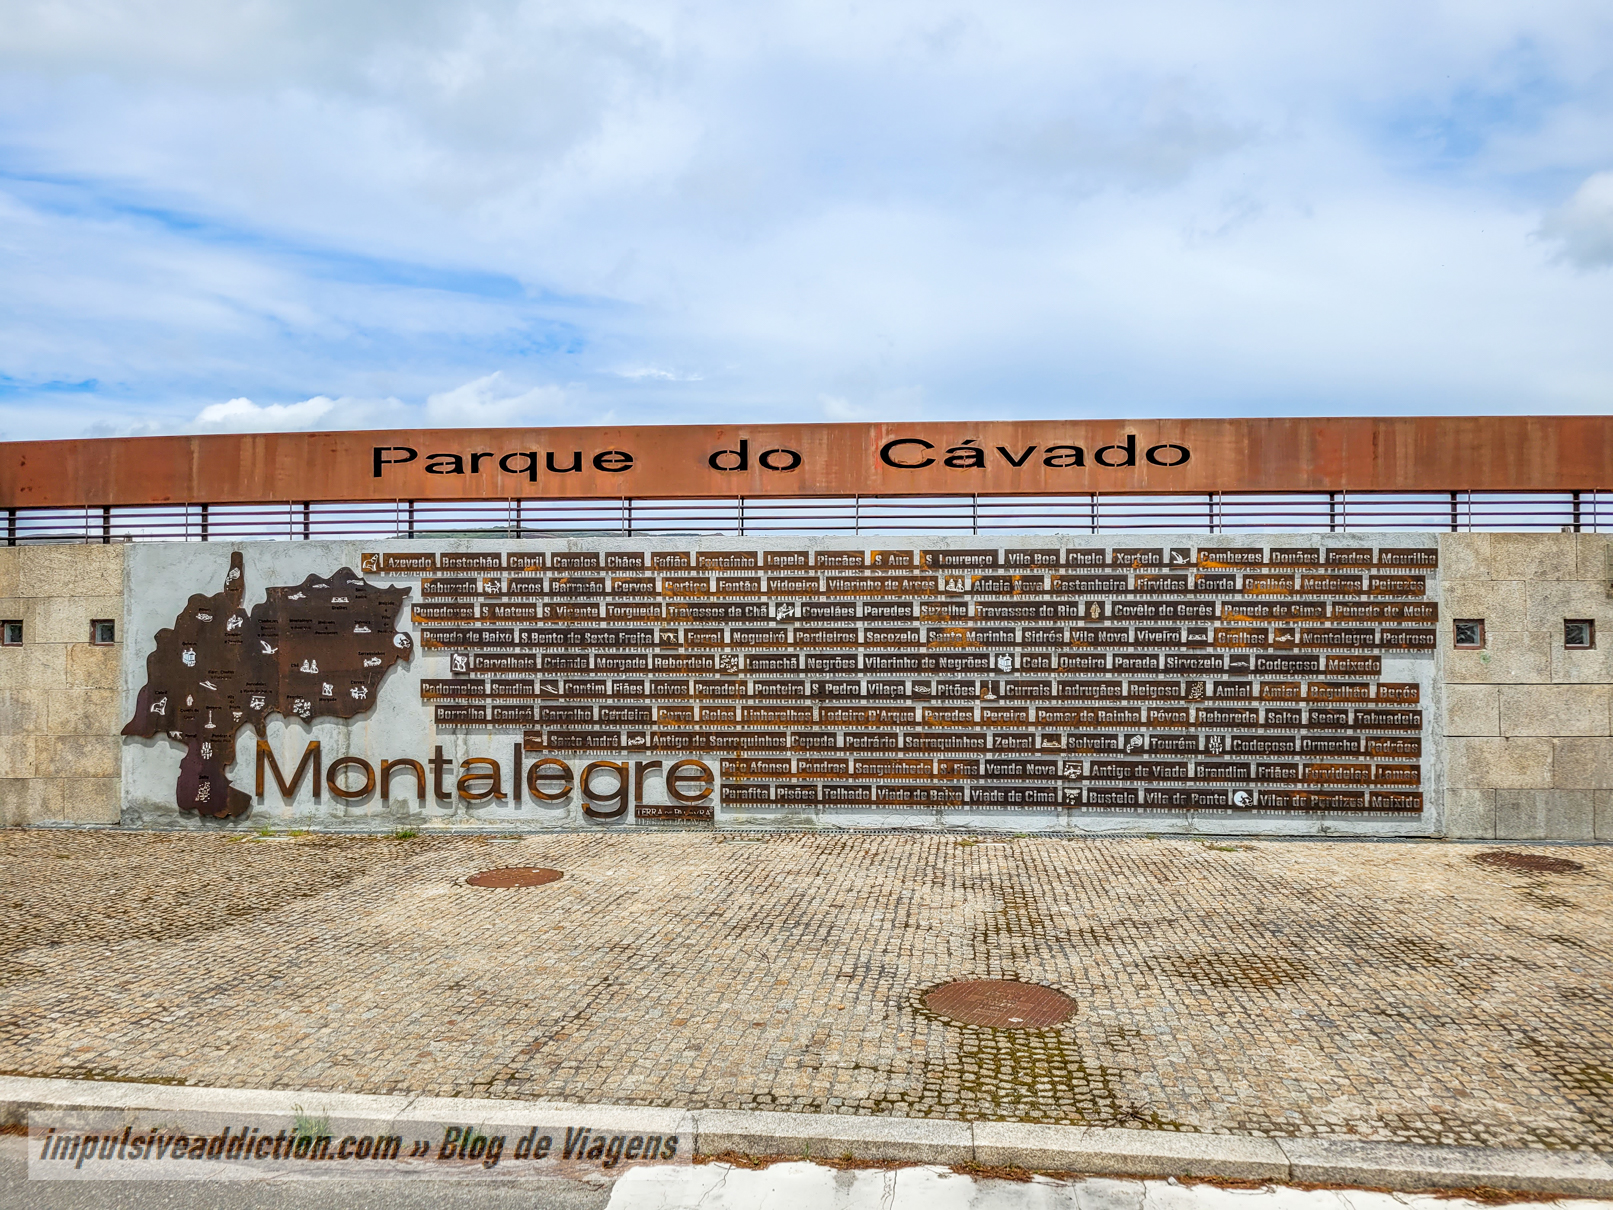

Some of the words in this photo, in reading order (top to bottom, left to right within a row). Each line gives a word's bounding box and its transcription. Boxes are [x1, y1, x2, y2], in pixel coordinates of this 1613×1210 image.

[373, 446, 634, 482] Parque
[708, 439, 802, 471] do
[879, 434, 1191, 469] Cávado
[256, 740, 714, 819] Montalegre
